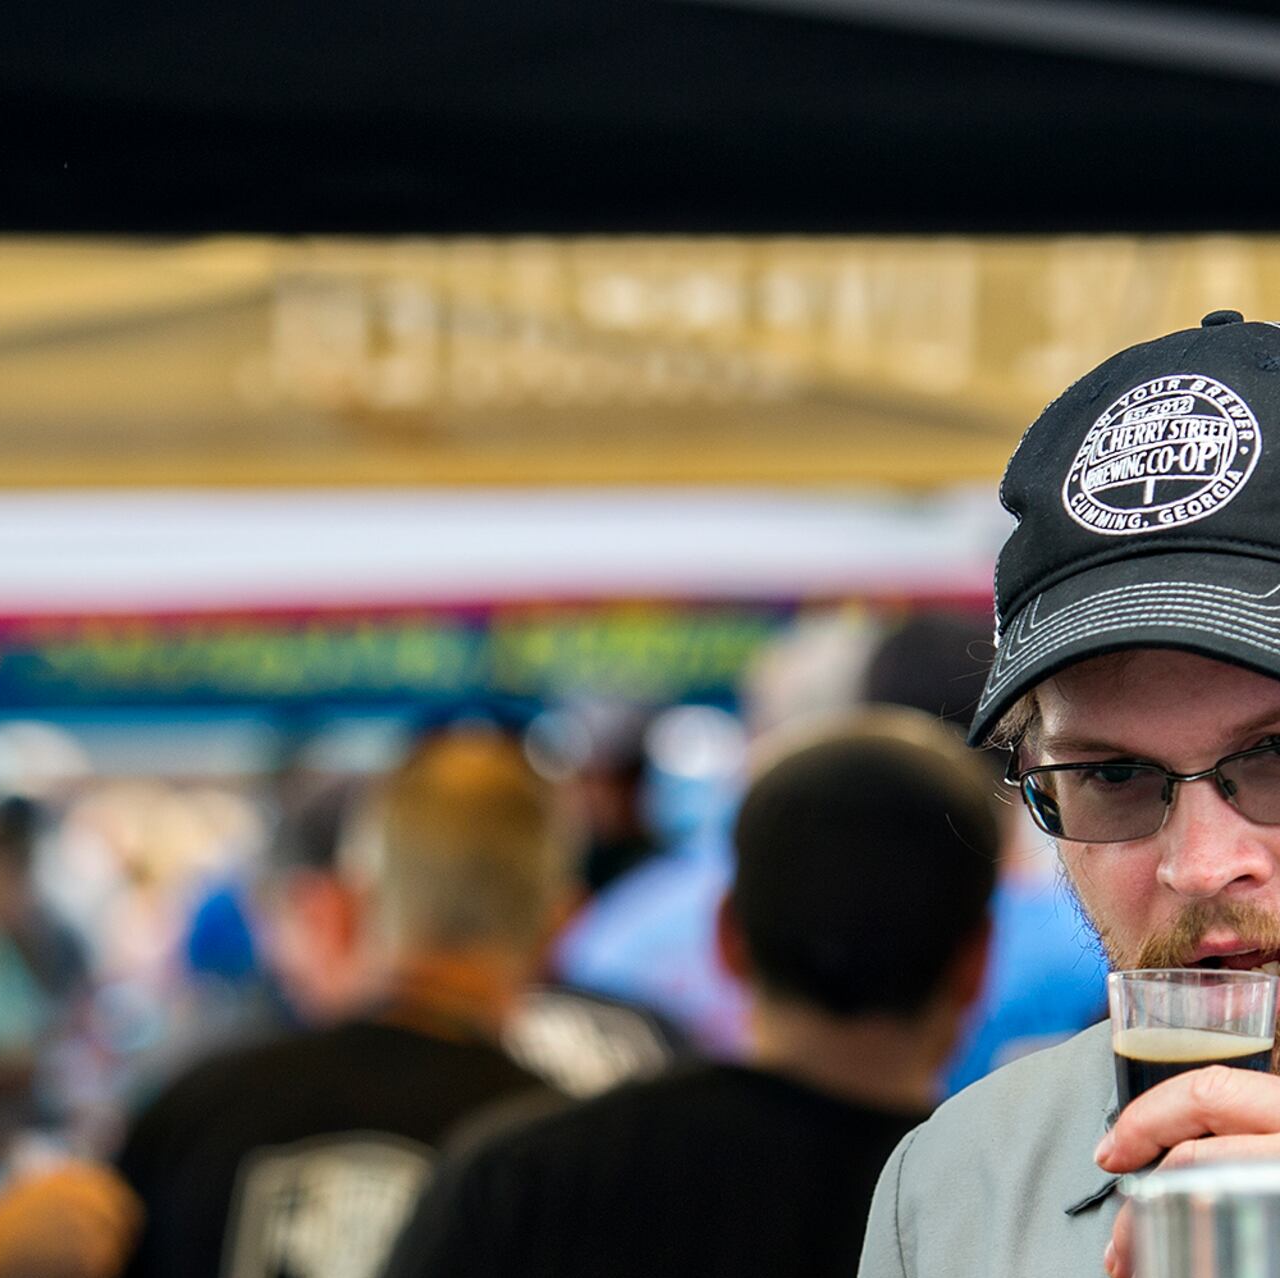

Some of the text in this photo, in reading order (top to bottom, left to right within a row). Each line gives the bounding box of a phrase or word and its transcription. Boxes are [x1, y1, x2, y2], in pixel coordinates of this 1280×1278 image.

[1119, 379, 1182, 407] YOUR
[1190, 379, 1255, 441] BREWER
[1097, 418, 1229, 457] CHERRY STREET
[1146, 441, 1219, 475] CO-OP
[1158, 469, 1244, 525] GEORGIA
